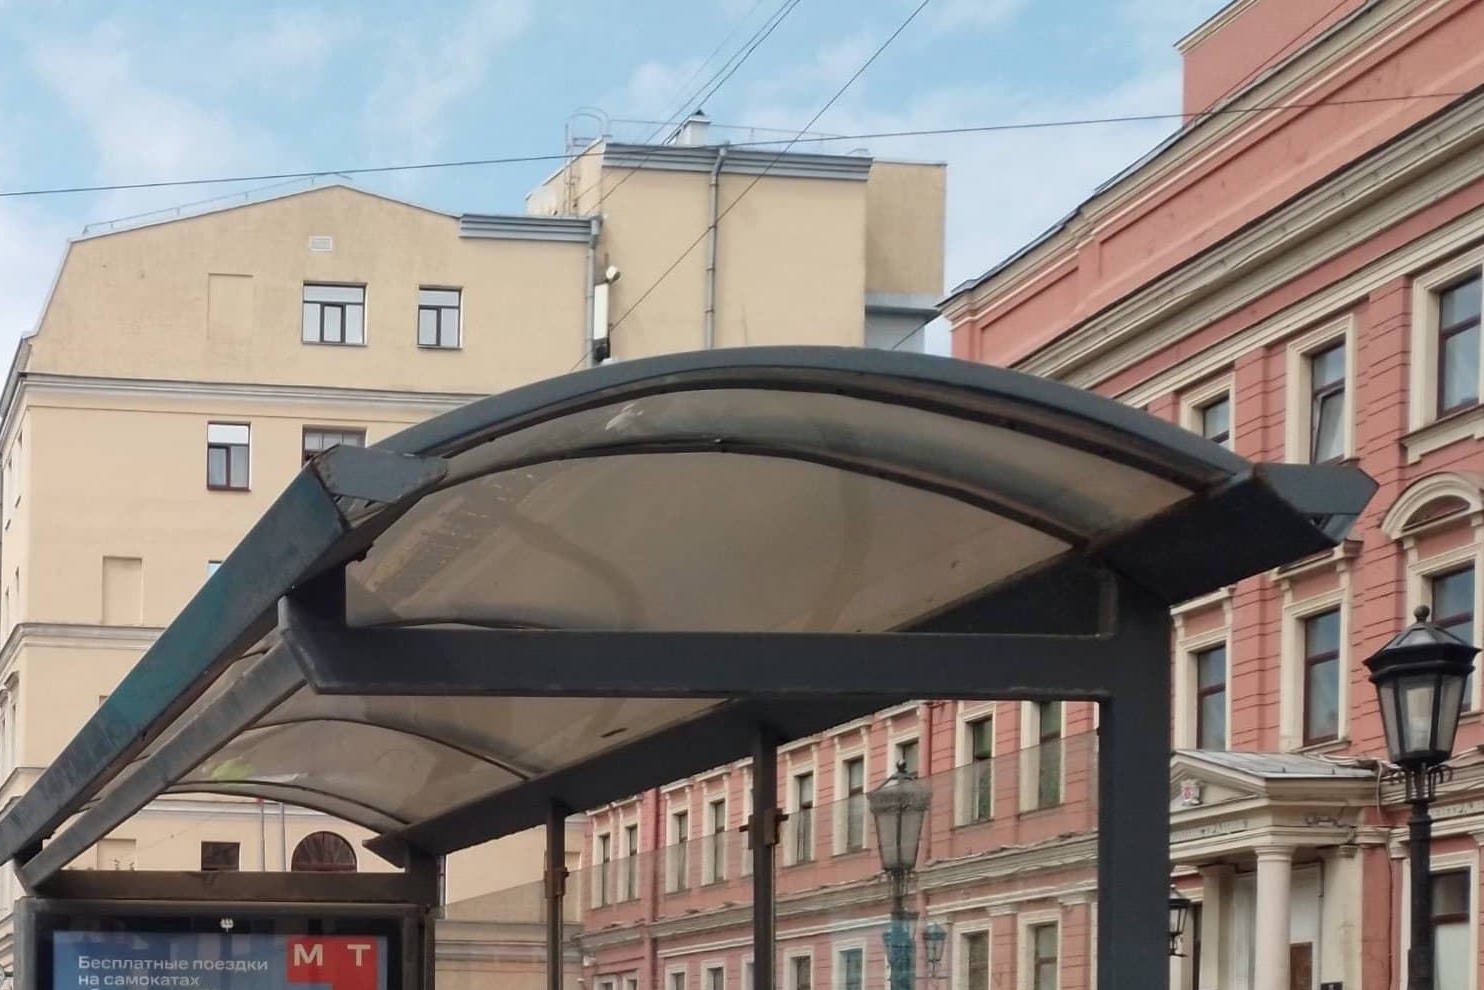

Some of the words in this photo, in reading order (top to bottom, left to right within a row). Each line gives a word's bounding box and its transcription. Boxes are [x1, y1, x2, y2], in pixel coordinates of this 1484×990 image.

[78, 956, 189, 970] Бесплатные
[193, 959, 268, 972] поездки
[78, 975, 100, 986] на
[104, 975, 200, 986] самокатах
